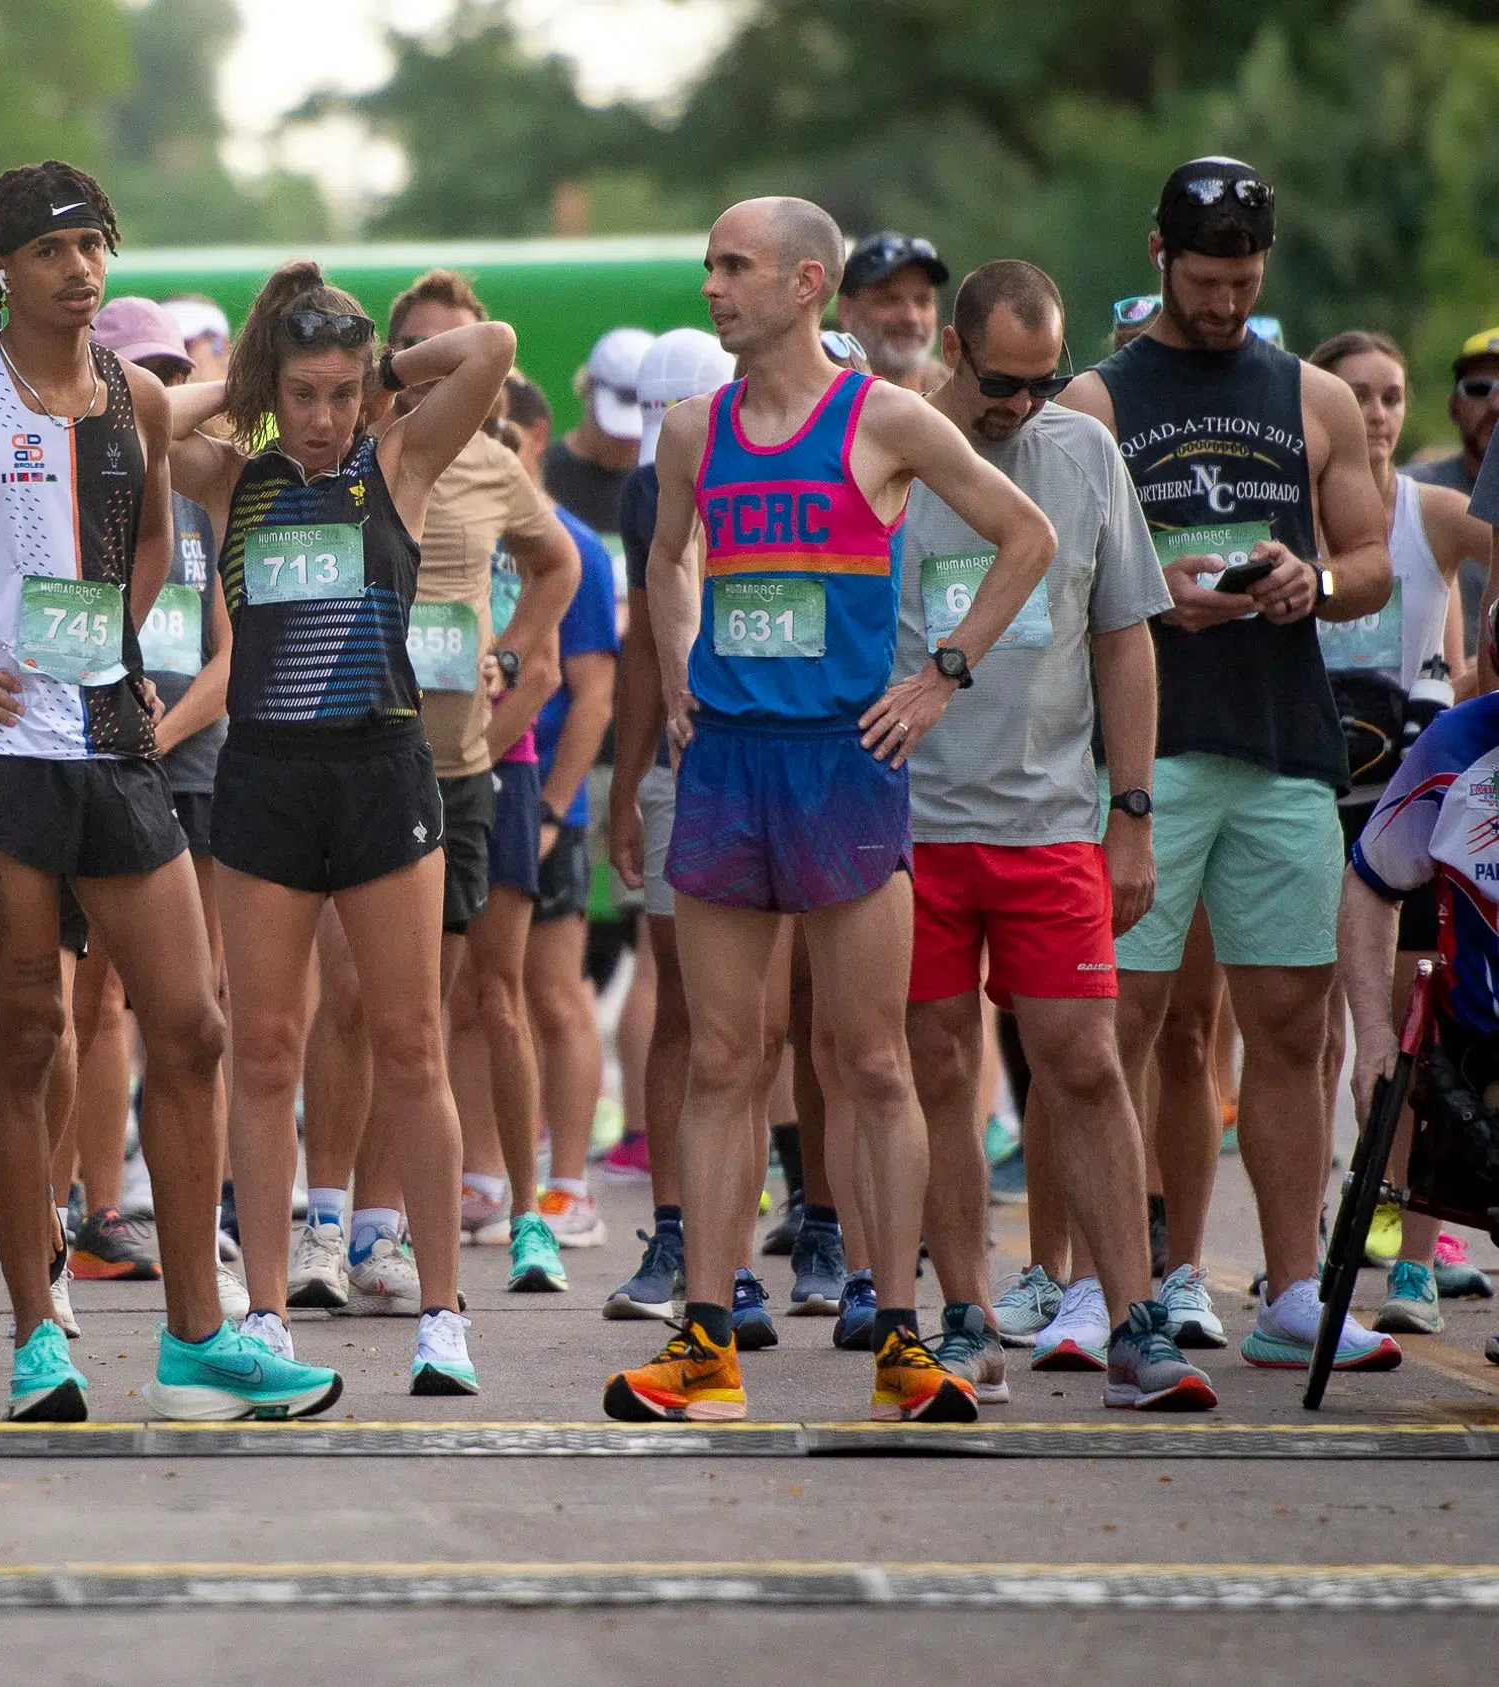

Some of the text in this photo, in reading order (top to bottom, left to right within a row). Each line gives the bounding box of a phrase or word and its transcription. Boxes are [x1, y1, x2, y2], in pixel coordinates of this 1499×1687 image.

[1119, 416, 1305, 458] QUAD-A-THON 2012
[1136, 479, 1193, 503] ORTHERN
[1236, 480, 1300, 504] COLORADO
[707, 491, 832, 549] FCRC
[181, 538, 207, 560] COL
[258, 530, 323, 548] HUMANRACE
[1168, 529, 1232, 546] HUMANRACE
[184, 560, 208, 583] FAX
[263, 553, 340, 587] 713
[935, 555, 996, 572] HUMANRAC
[40, 582, 103, 605] HUMANRACE
[725, 583, 784, 602] HUMANRACE
[43, 606, 109, 647] 745
[147, 607, 185, 638] 08
[728, 608, 795, 643] 631
[406, 625, 463, 655] 658
